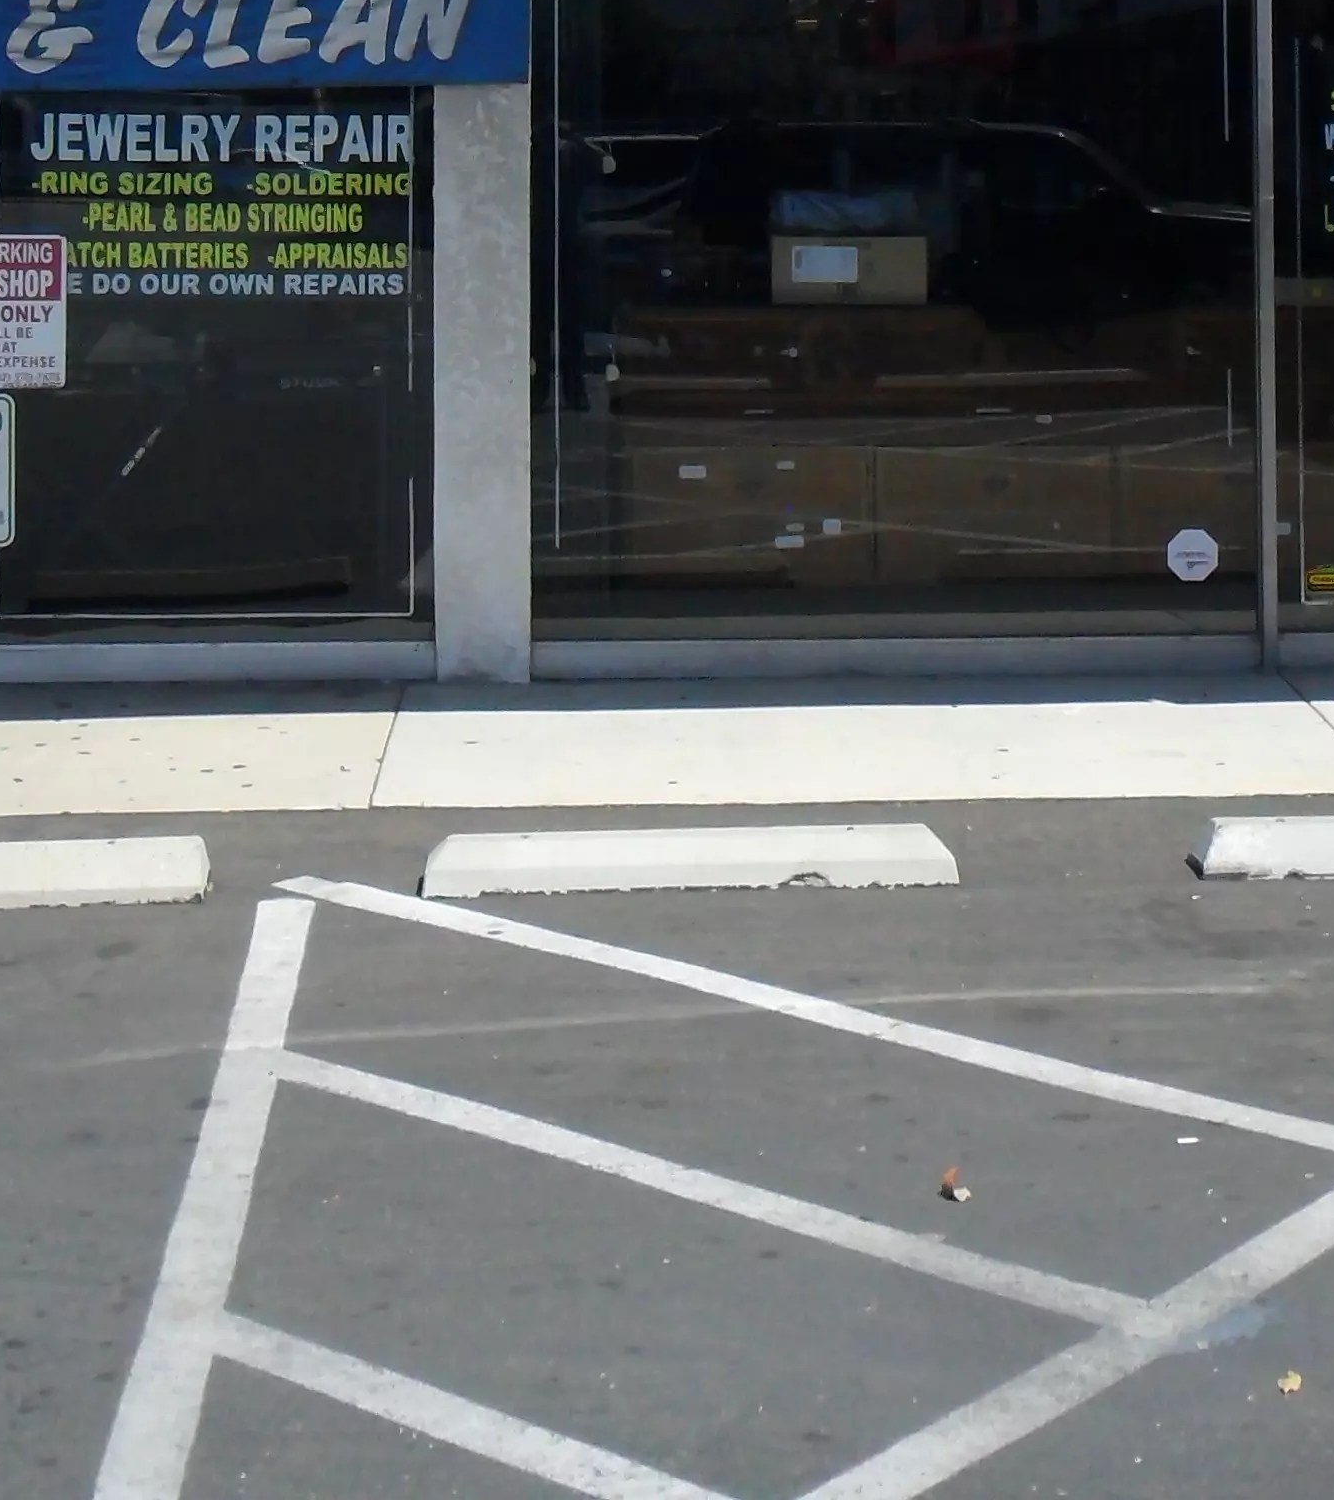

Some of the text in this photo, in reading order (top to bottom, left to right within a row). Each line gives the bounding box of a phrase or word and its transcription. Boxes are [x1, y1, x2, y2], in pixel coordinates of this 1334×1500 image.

[30, 113, 413, 163] JEWELRY REPAIR
[118, 171, 213, 196] SIZING
[163, 203, 177, 232] &
[185, 203, 241, 232] BEAD
[247, 203, 363, 233] STRINGING
[128, 241, 249, 269] BATTERIES
[92, 273, 131, 295] DO
[139, 273, 200, 296] OUR
[209, 273, 274, 296] OWN
[284, 273, 404, 296] REPAIRS
[0, 305, 54, 323] ONLY
[2, 341, 17, 353] AT
